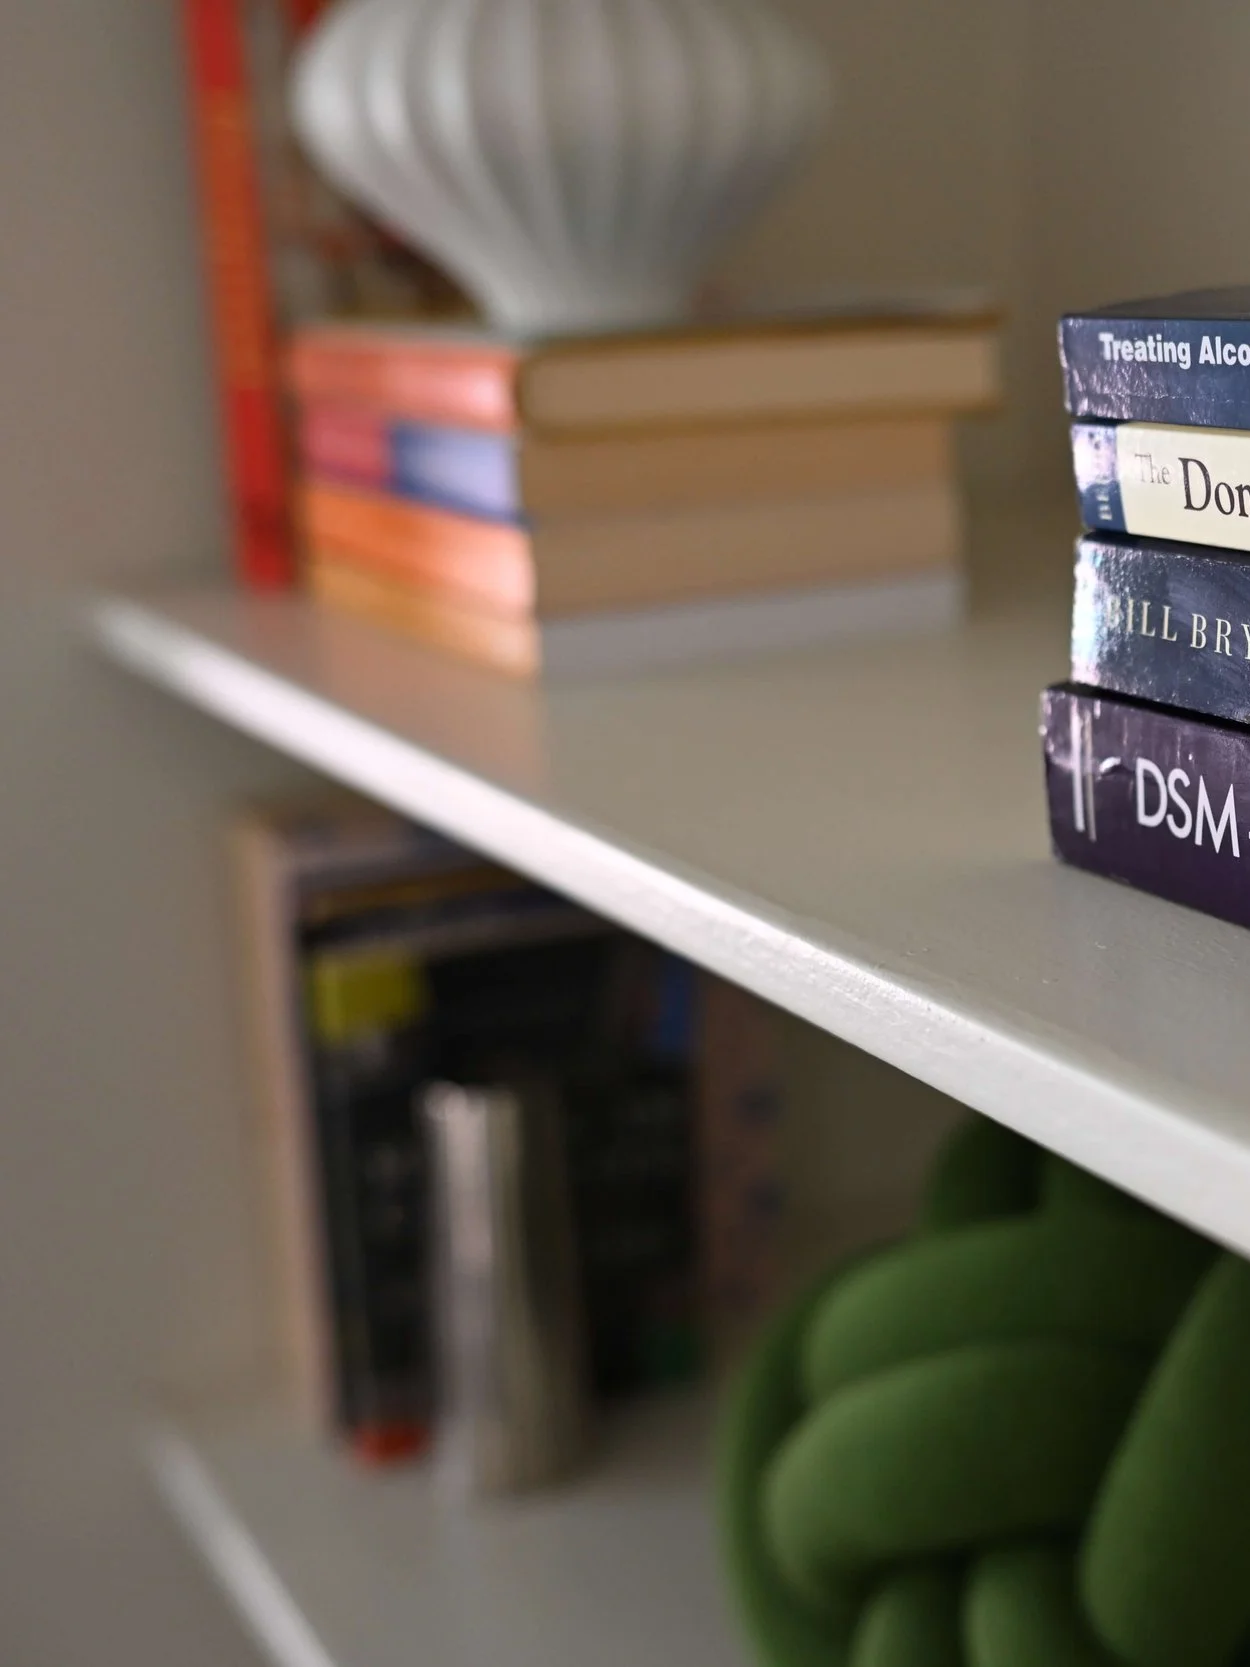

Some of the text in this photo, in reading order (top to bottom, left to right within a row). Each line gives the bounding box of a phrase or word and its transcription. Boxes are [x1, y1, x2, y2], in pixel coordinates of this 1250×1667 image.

[1099, 332, 1192, 369] Treating
[1134, 452, 1171, 485] The
[1107, 597, 1178, 642] BILL
